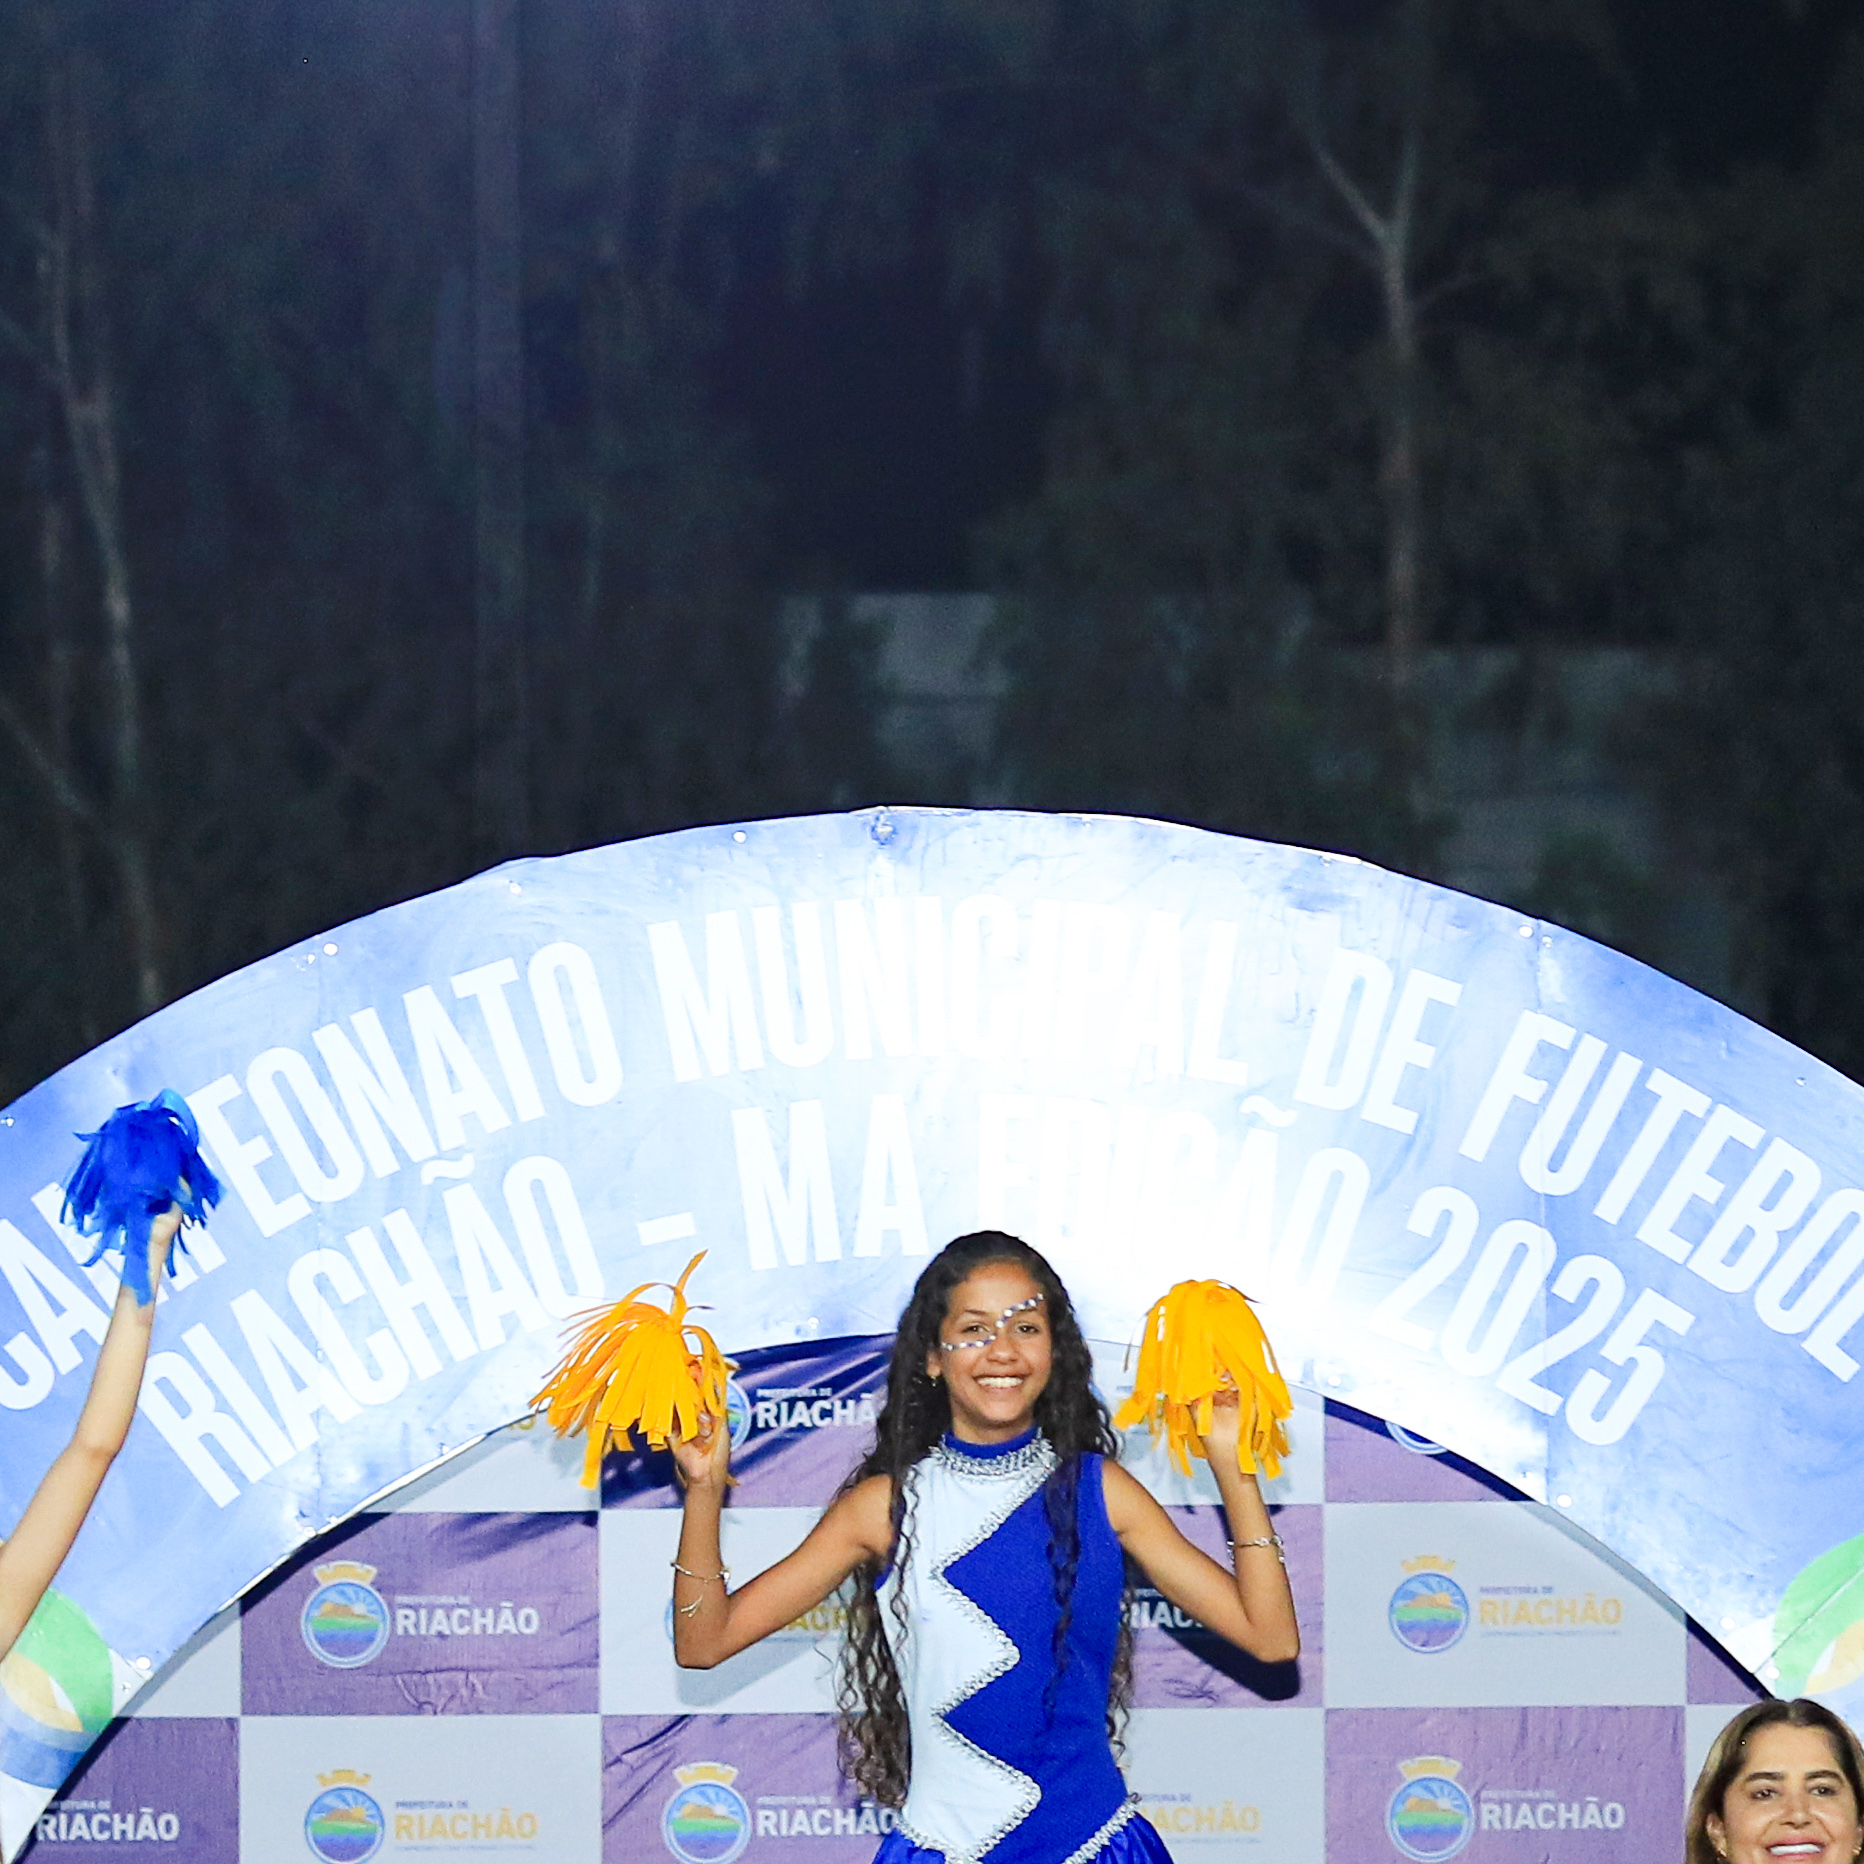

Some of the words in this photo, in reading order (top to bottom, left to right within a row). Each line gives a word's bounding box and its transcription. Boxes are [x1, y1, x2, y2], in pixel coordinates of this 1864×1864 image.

[647, 895, 1248, 1085] MUNICIPAL
[1294, 944, 1464, 1135] DE
[137, 1153, 606, 1508] RIACHÃO
[730, 1093, 929, 1270] MA
[1369, 1185, 1696, 1446] 2025
[756, 1395, 882, 1428] RIACHÃ
[395, 1601, 540, 1635] RIACHÃO
[1480, 1593, 1623, 1626] RIACHÃO
[37, 1806, 181, 1841] RIACHÃO
[394, 1807, 538, 1840] RIACHÃO
[757, 1802, 895, 1836] RIACHÃO
[1139, 1800, 1262, 1833] ACHÃO
[1481, 1796, 1626, 1830] RIACHÃO
